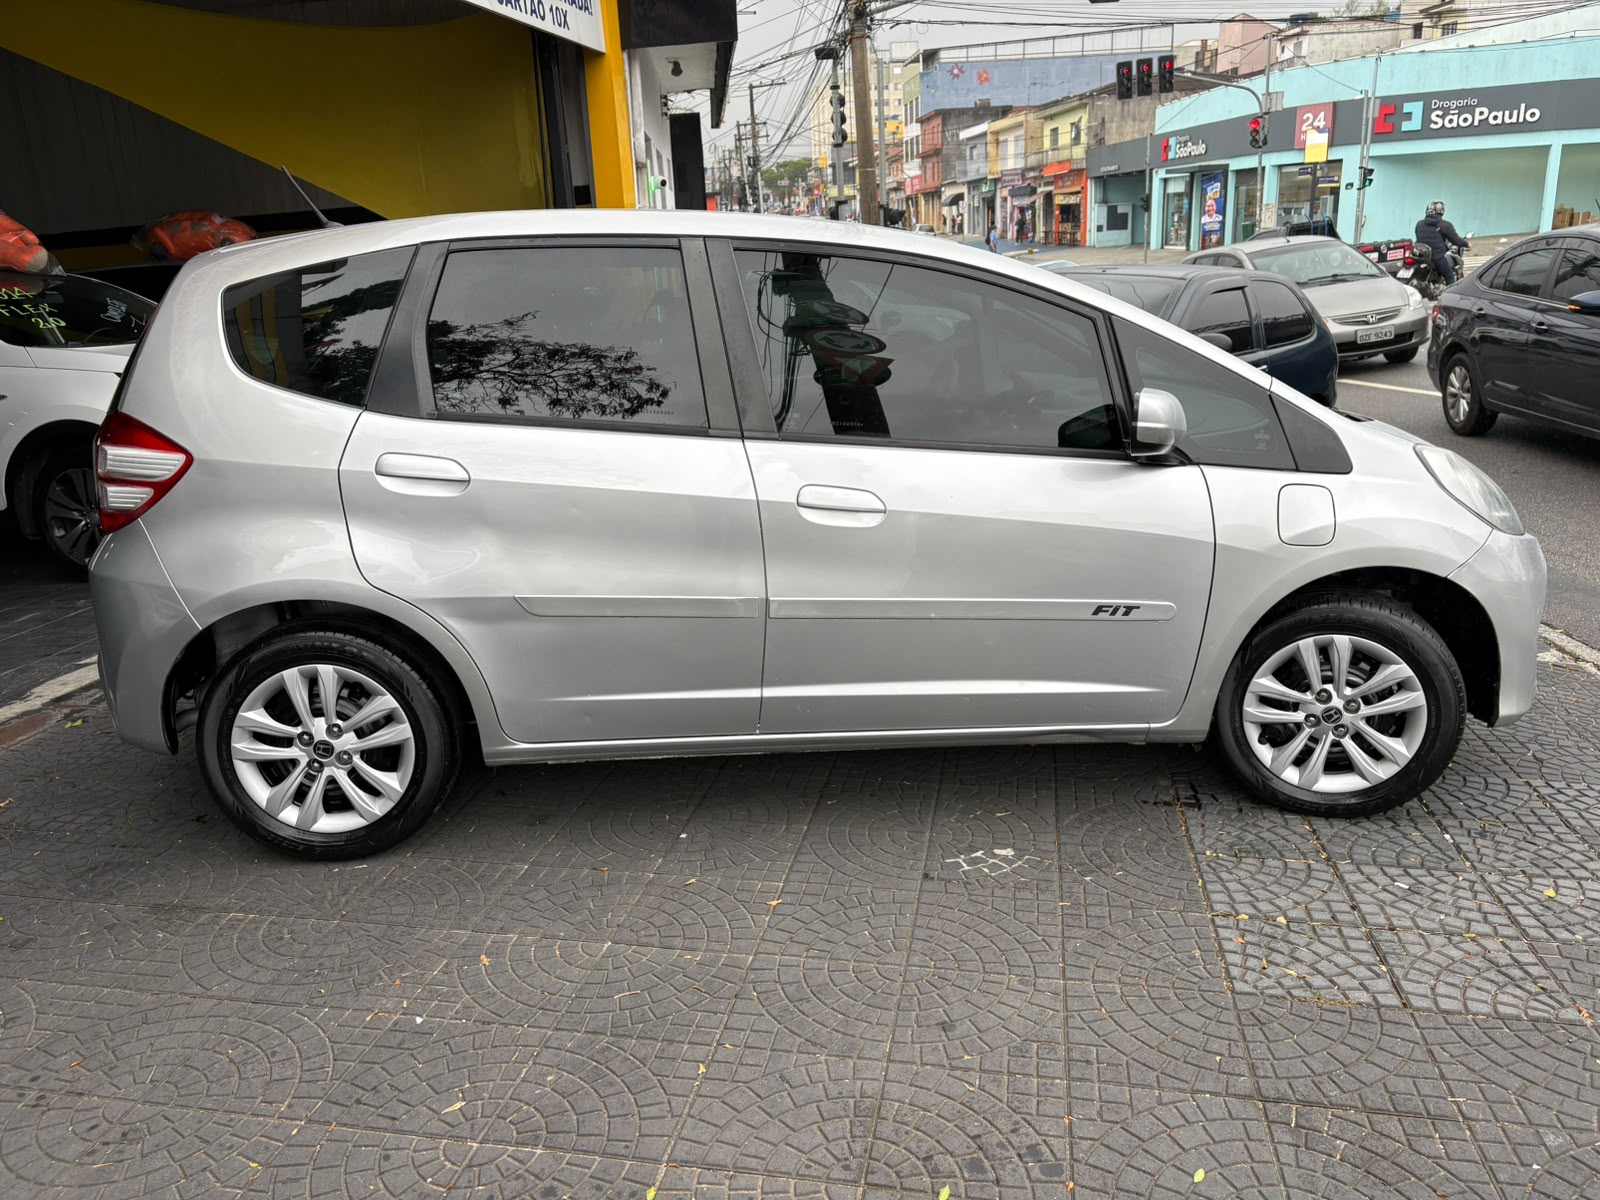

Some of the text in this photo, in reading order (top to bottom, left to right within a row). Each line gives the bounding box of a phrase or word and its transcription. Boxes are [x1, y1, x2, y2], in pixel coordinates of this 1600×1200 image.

[497, 0, 570, 30] ARTÃO 10X
[1431, 96, 1478, 110] Drogaria
[1301, 111, 1326, 132] 24
[1429, 103, 1541, 130] SãoPaulo
[0, 303, 58, 317] FLEX
[1091, 605, 1141, 617] FIT
